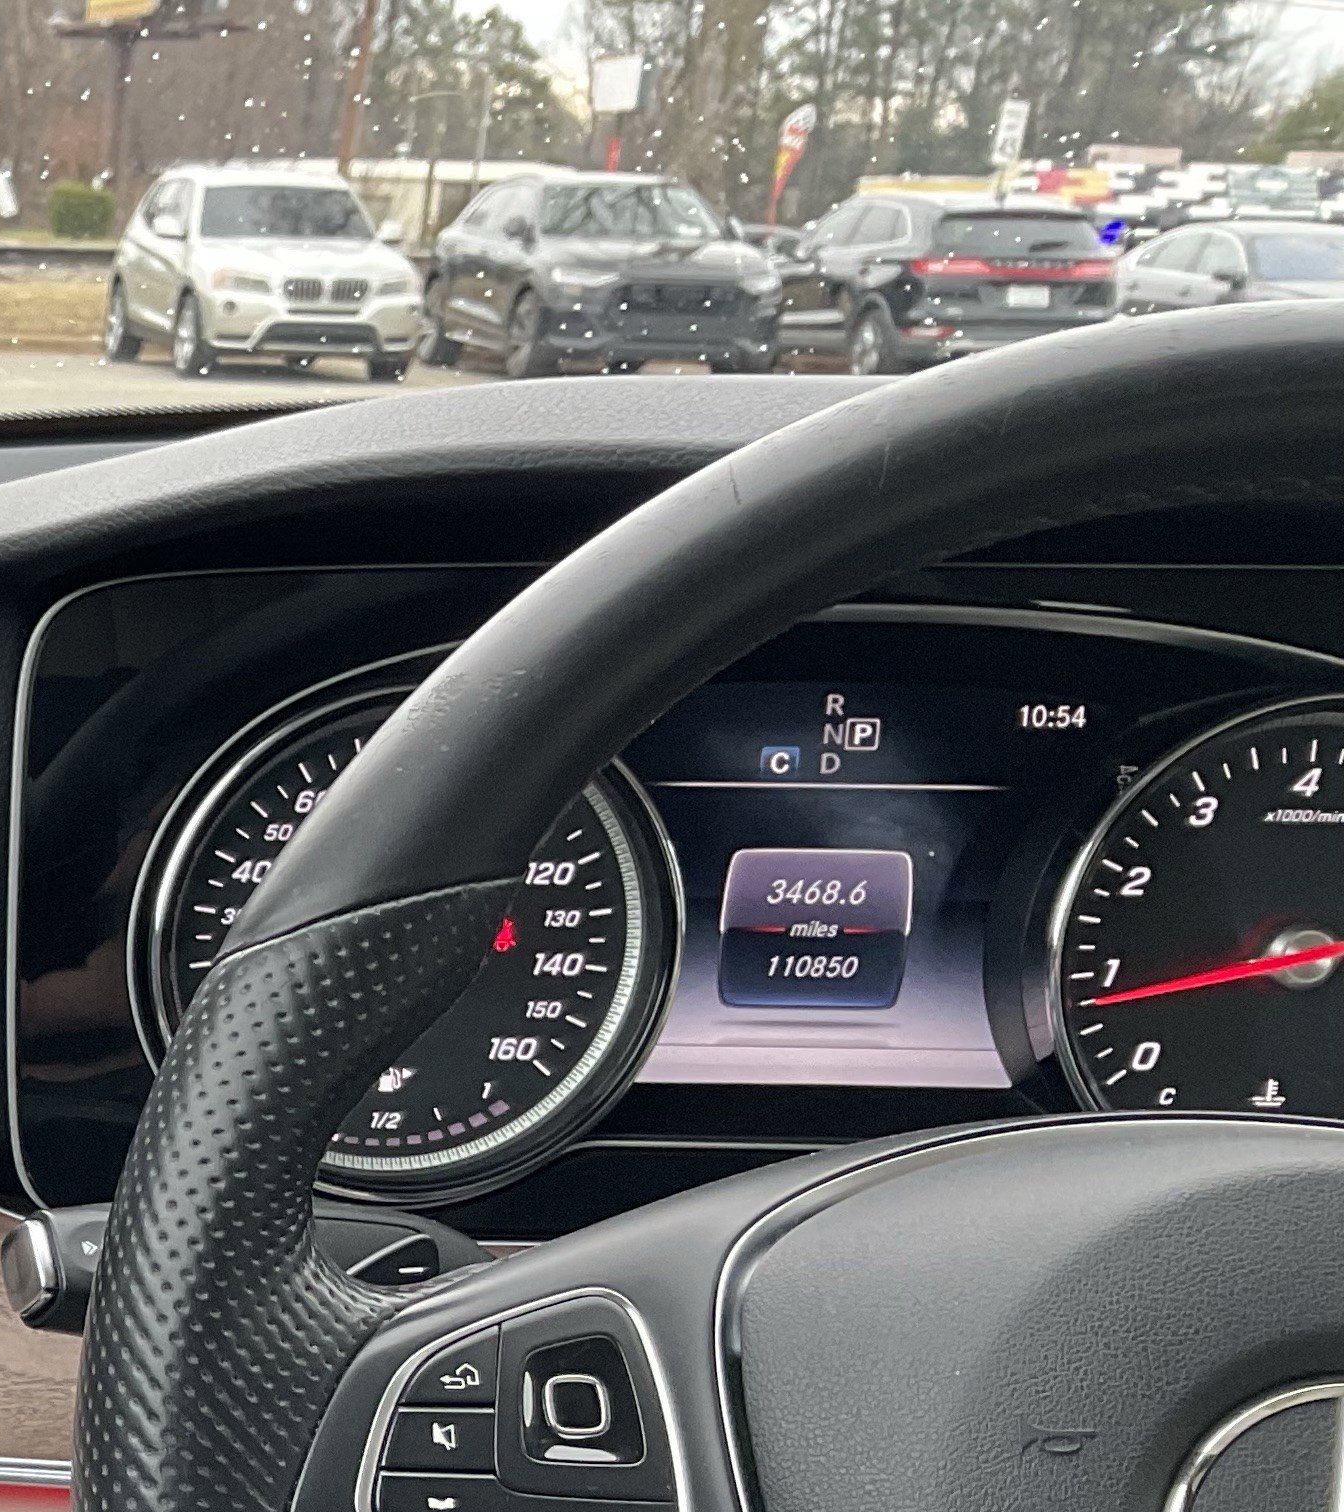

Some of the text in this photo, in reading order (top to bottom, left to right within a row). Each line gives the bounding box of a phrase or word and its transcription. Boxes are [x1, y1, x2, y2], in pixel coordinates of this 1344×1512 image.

[825, 693, 845, 716] R
[1020, 703, 1087, 729] 10:54
[822, 723, 873, 745] N P
[770, 752, 790, 774] C
[819, 752, 841, 774] D
[1292, 767, 1323, 797] 4
[1189, 796, 1219, 828] 3
[263, 823, 293, 841] 50
[231, 860, 272, 883] 40
[525, 862, 576, 886] 120
[1120, 866, 1152, 896] 2
[766, 879, 868, 905] 3468.6
[220, 907, 242, 925] 3
[544, 910, 581, 928] 130
[789, 920, 839, 938] miles
[533, 953, 584, 976] 140
[768, 955, 859, 979] 110850
[1102, 958, 1121, 988] 1
[525, 1001, 562, 1018] 150
[489, 1037, 537, 1061] 160
[1131, 1041, 1162, 1071] 0
[481, 1082, 492, 1099] 1
[370, 1111, 401, 1129] 1/2
